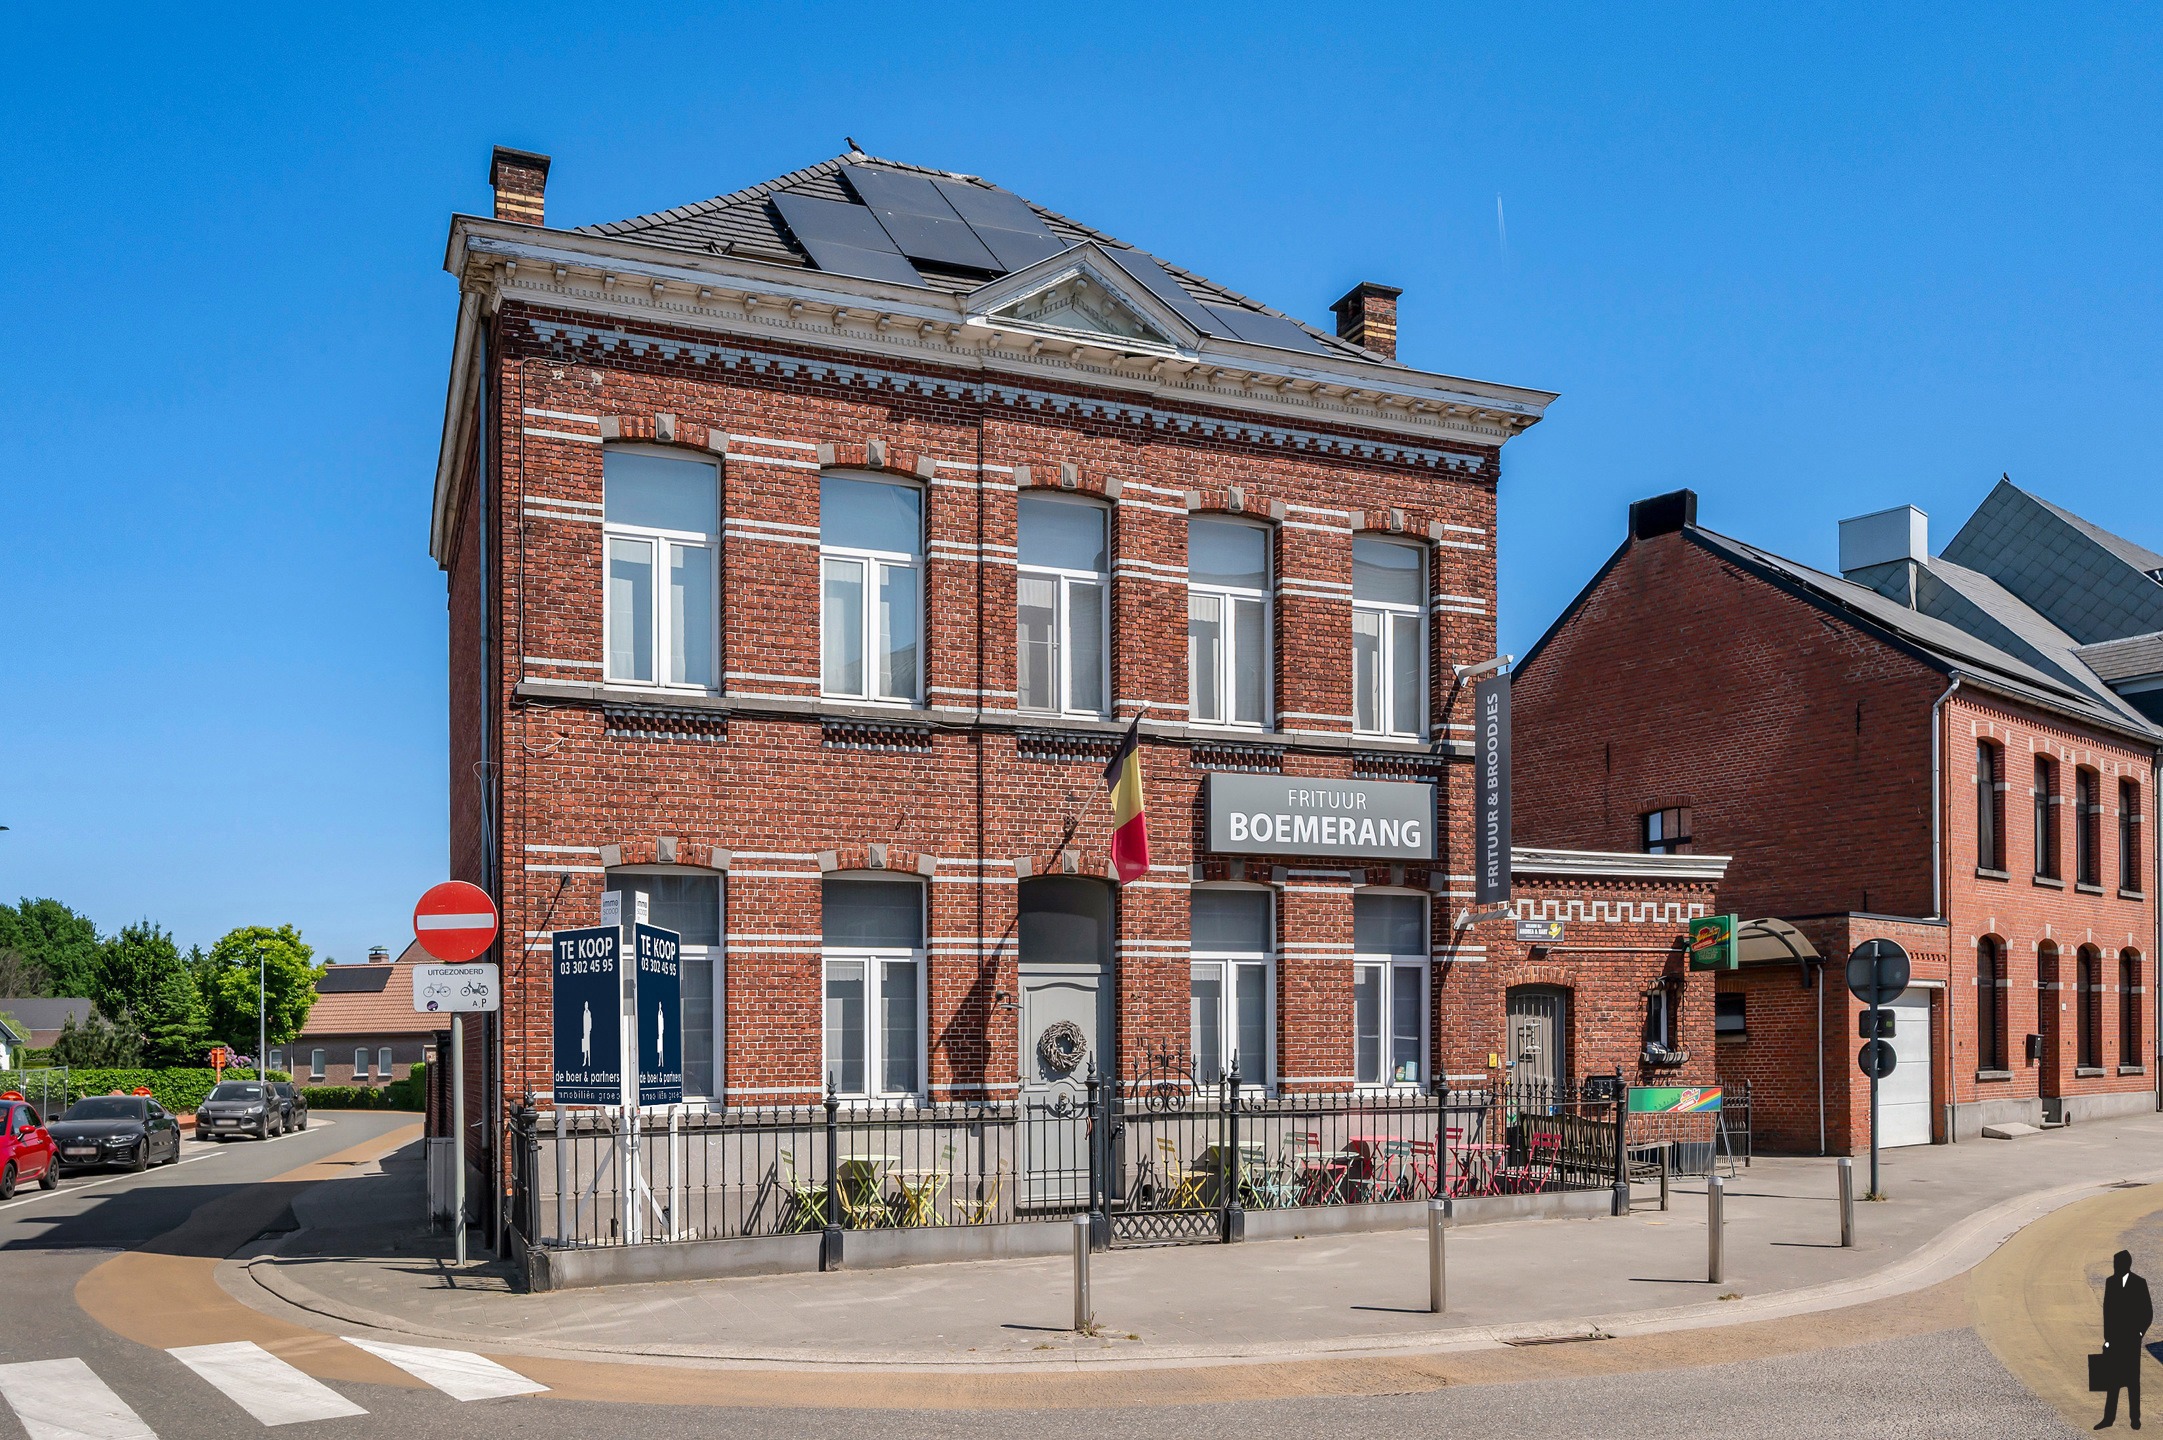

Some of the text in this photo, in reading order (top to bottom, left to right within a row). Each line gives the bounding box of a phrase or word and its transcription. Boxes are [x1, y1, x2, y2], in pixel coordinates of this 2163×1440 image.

[1288, 788, 1367, 810] FRITUUR
[1487, 692, 1499, 889] FRITUUR & BROODJES
[1230, 812, 1421, 848] BOEMERANG
[560, 937, 613, 960] TE KOOP
[641, 934, 676, 961] TE KOOP
[560, 958, 613, 975] 03 302 45 95
[641, 957, 677, 976] 03 302 45 95
[555, 1070, 620, 1085] de boer & partners
